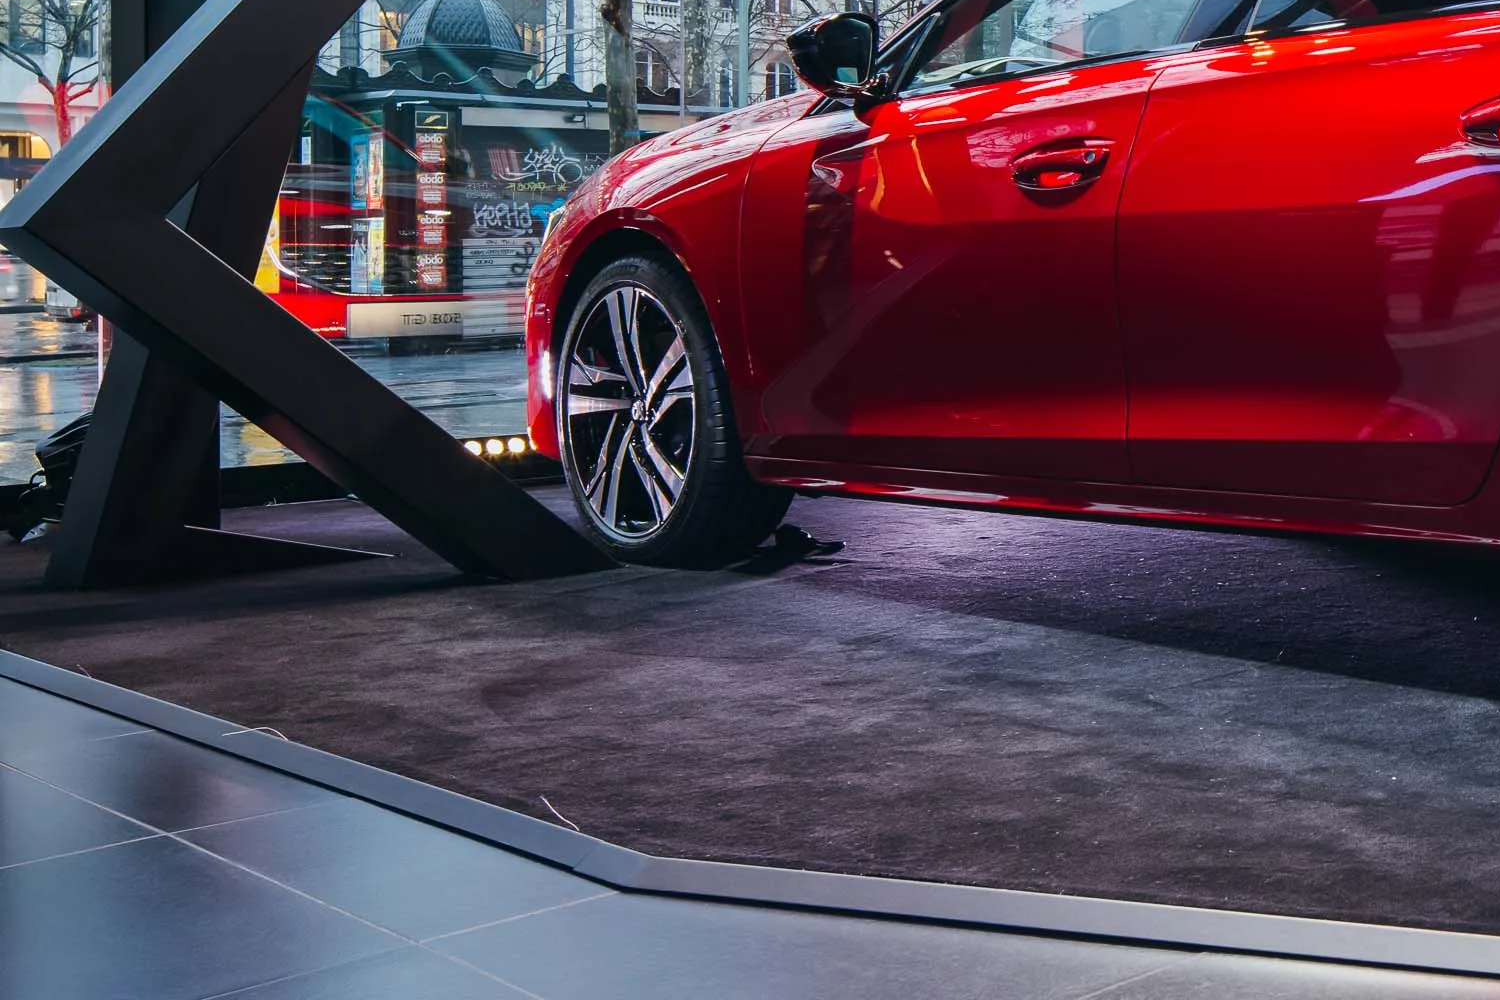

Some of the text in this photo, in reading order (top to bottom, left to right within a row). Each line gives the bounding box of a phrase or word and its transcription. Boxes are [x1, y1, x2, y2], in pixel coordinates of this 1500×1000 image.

[419, 133, 442, 143] ebdo
[419, 173, 443, 184] ebdo
[420, 214, 444, 225] ebdo
[419, 254, 443, 265] ebdo
